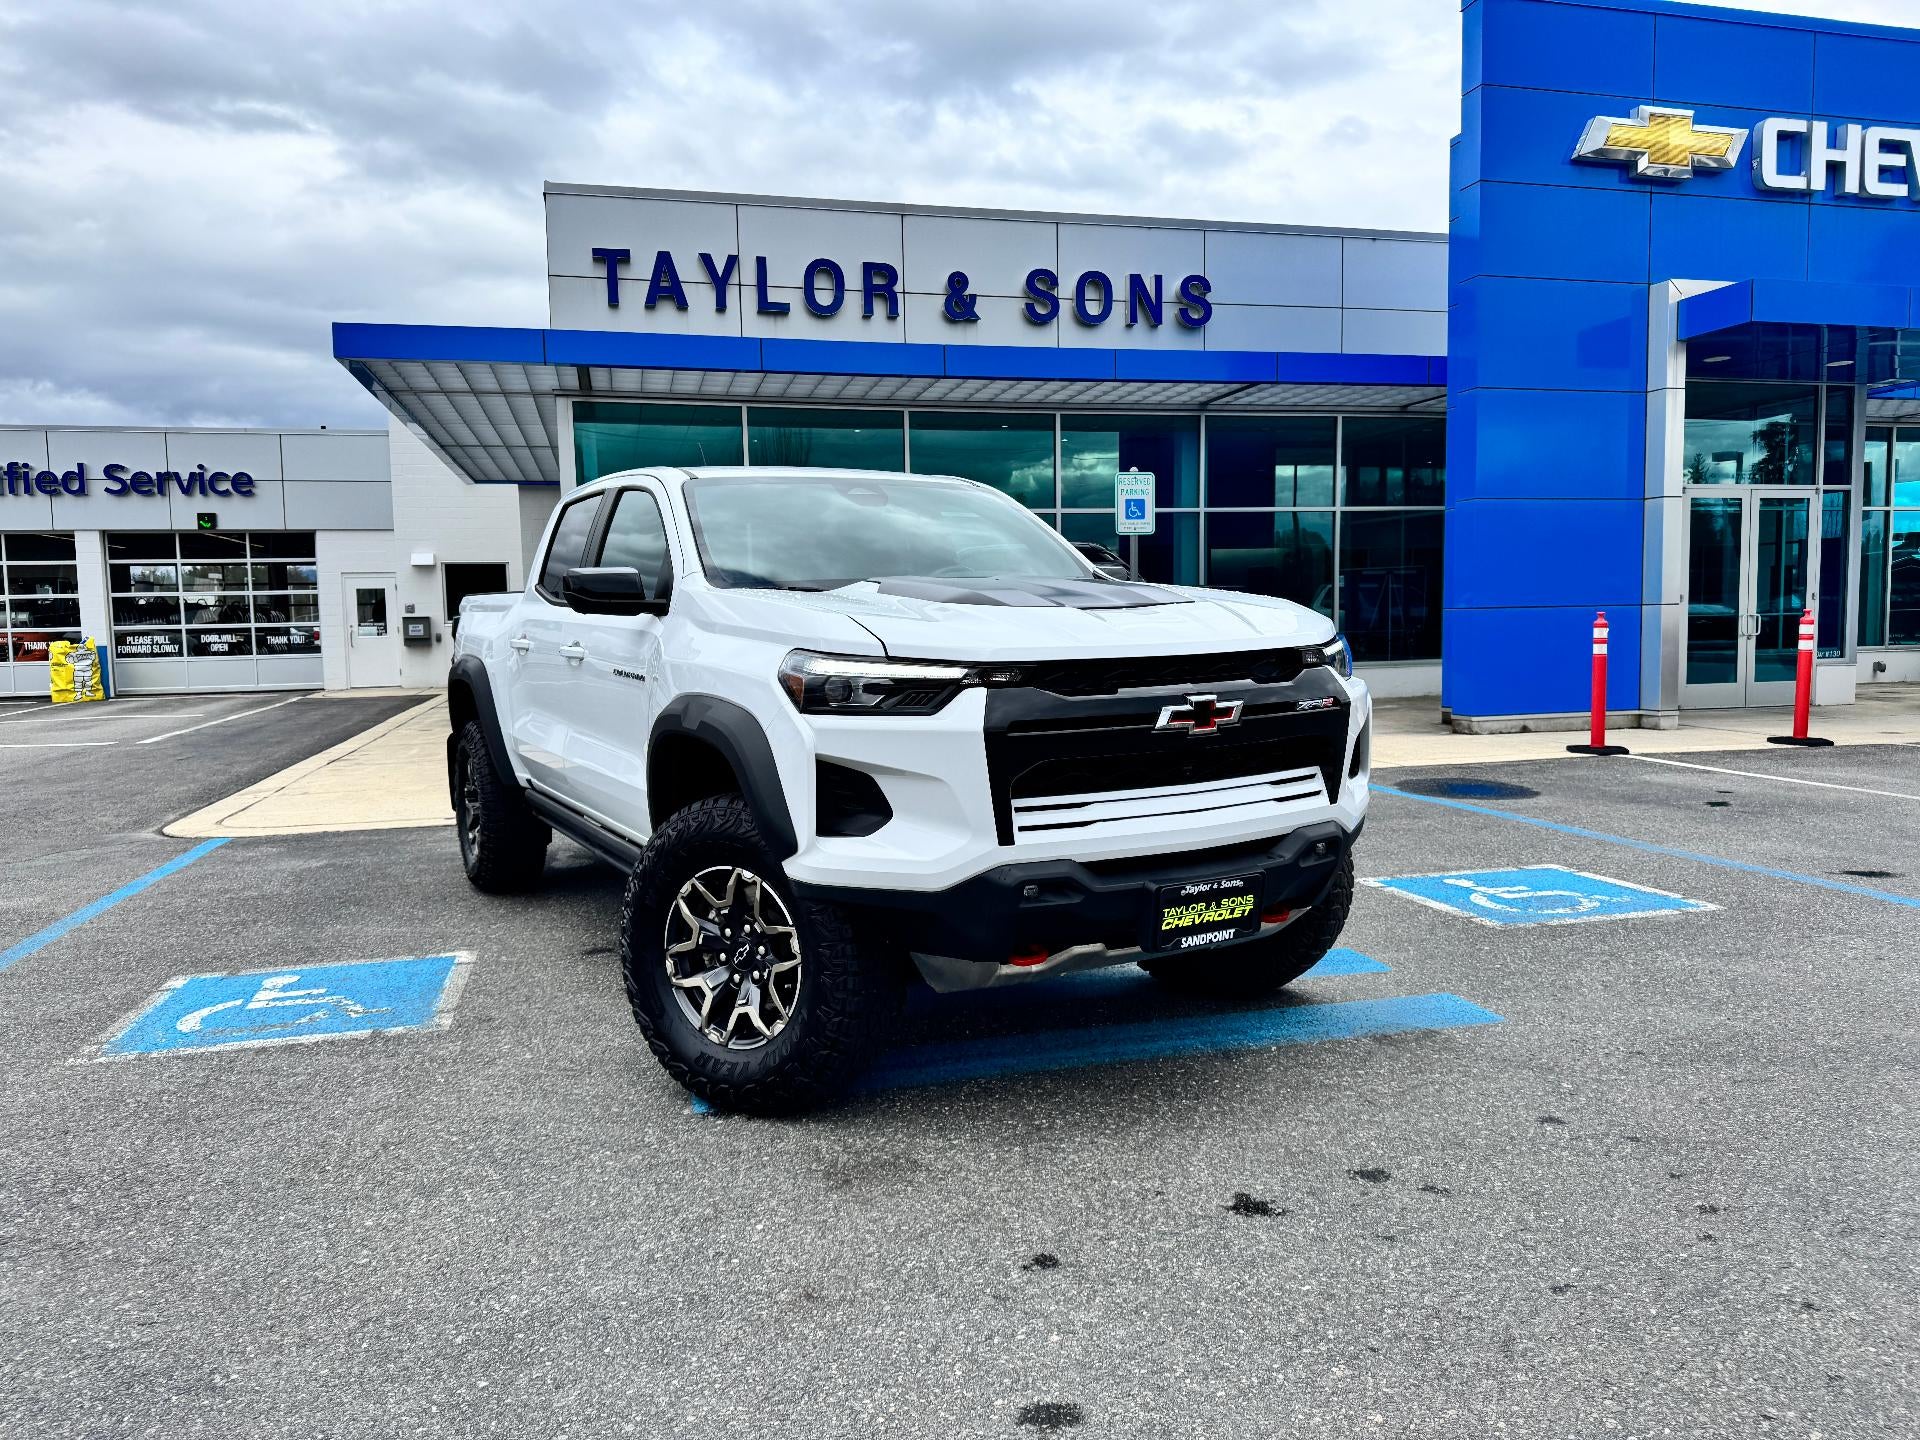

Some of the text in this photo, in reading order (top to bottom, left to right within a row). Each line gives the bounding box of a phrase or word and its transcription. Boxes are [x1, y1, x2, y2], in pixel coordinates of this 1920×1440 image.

[1753, 117, 1920, 198] CHE
[591, 247, 1213, 328] TAYLOR & SONS
[0, 461, 256, 496] fied Service
[1118, 477, 1151, 486] RESERVED
[1120, 488, 1150, 496] PARKING
[126, 635, 171, 645] PLEASE PULL
[200, 633, 237, 643] DOOR WILL
[266, 635, 305, 645] THANK YOU!
[24, 641, 48, 650] THANK
[117, 644, 180, 654] FORWARD SLOWLY
[210, 643, 229, 652] OPEN
[1184, 882, 1212, 896] Taylor
[1219, 879, 1240, 889] Sons
[1162, 894, 1254, 918] TAYLOR & SONS
[1161, 905, 1254, 931] CHEVROLET
[1180, 928, 1236, 949] SANDPOINT
